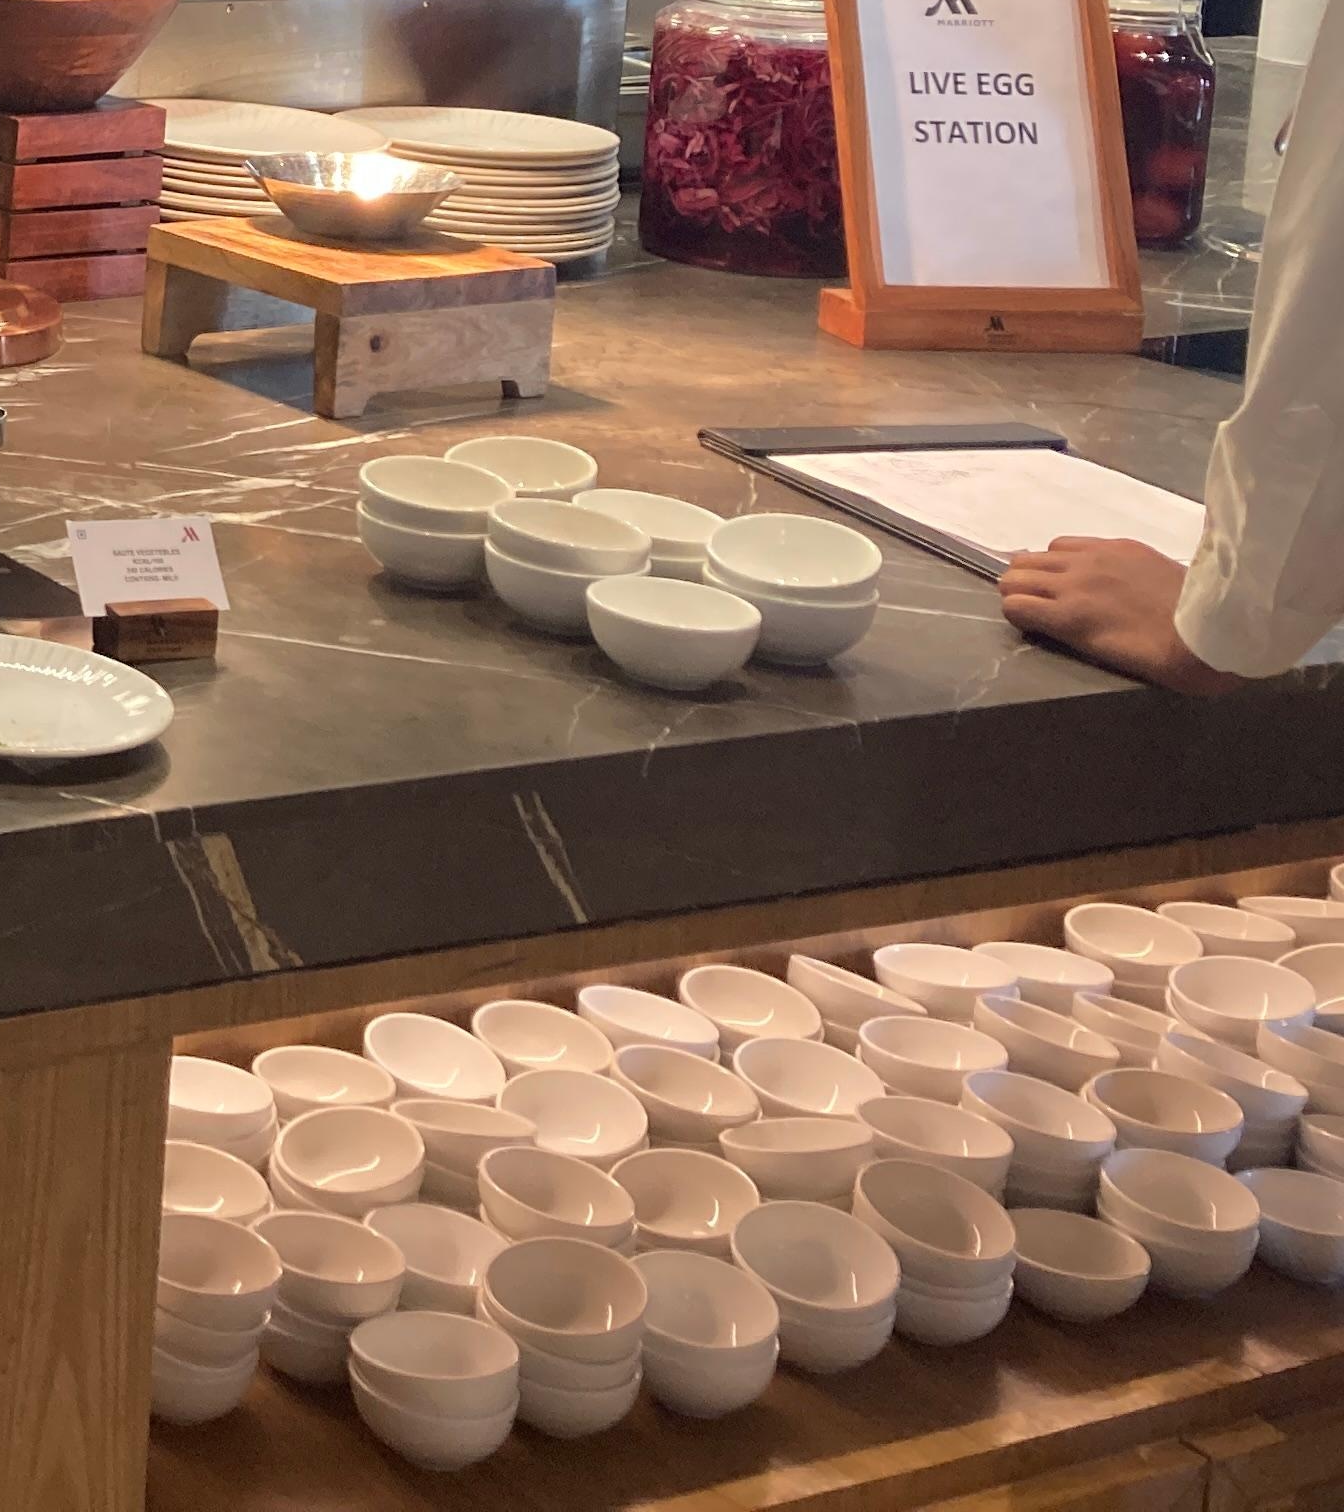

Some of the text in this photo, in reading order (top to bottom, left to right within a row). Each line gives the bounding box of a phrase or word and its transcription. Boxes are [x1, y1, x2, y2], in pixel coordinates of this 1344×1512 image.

[937, 19, 995, 27] MARRIOTT
[909, 71, 1035, 96] LIVE EGG
[914, 120, 1039, 145] STATION
